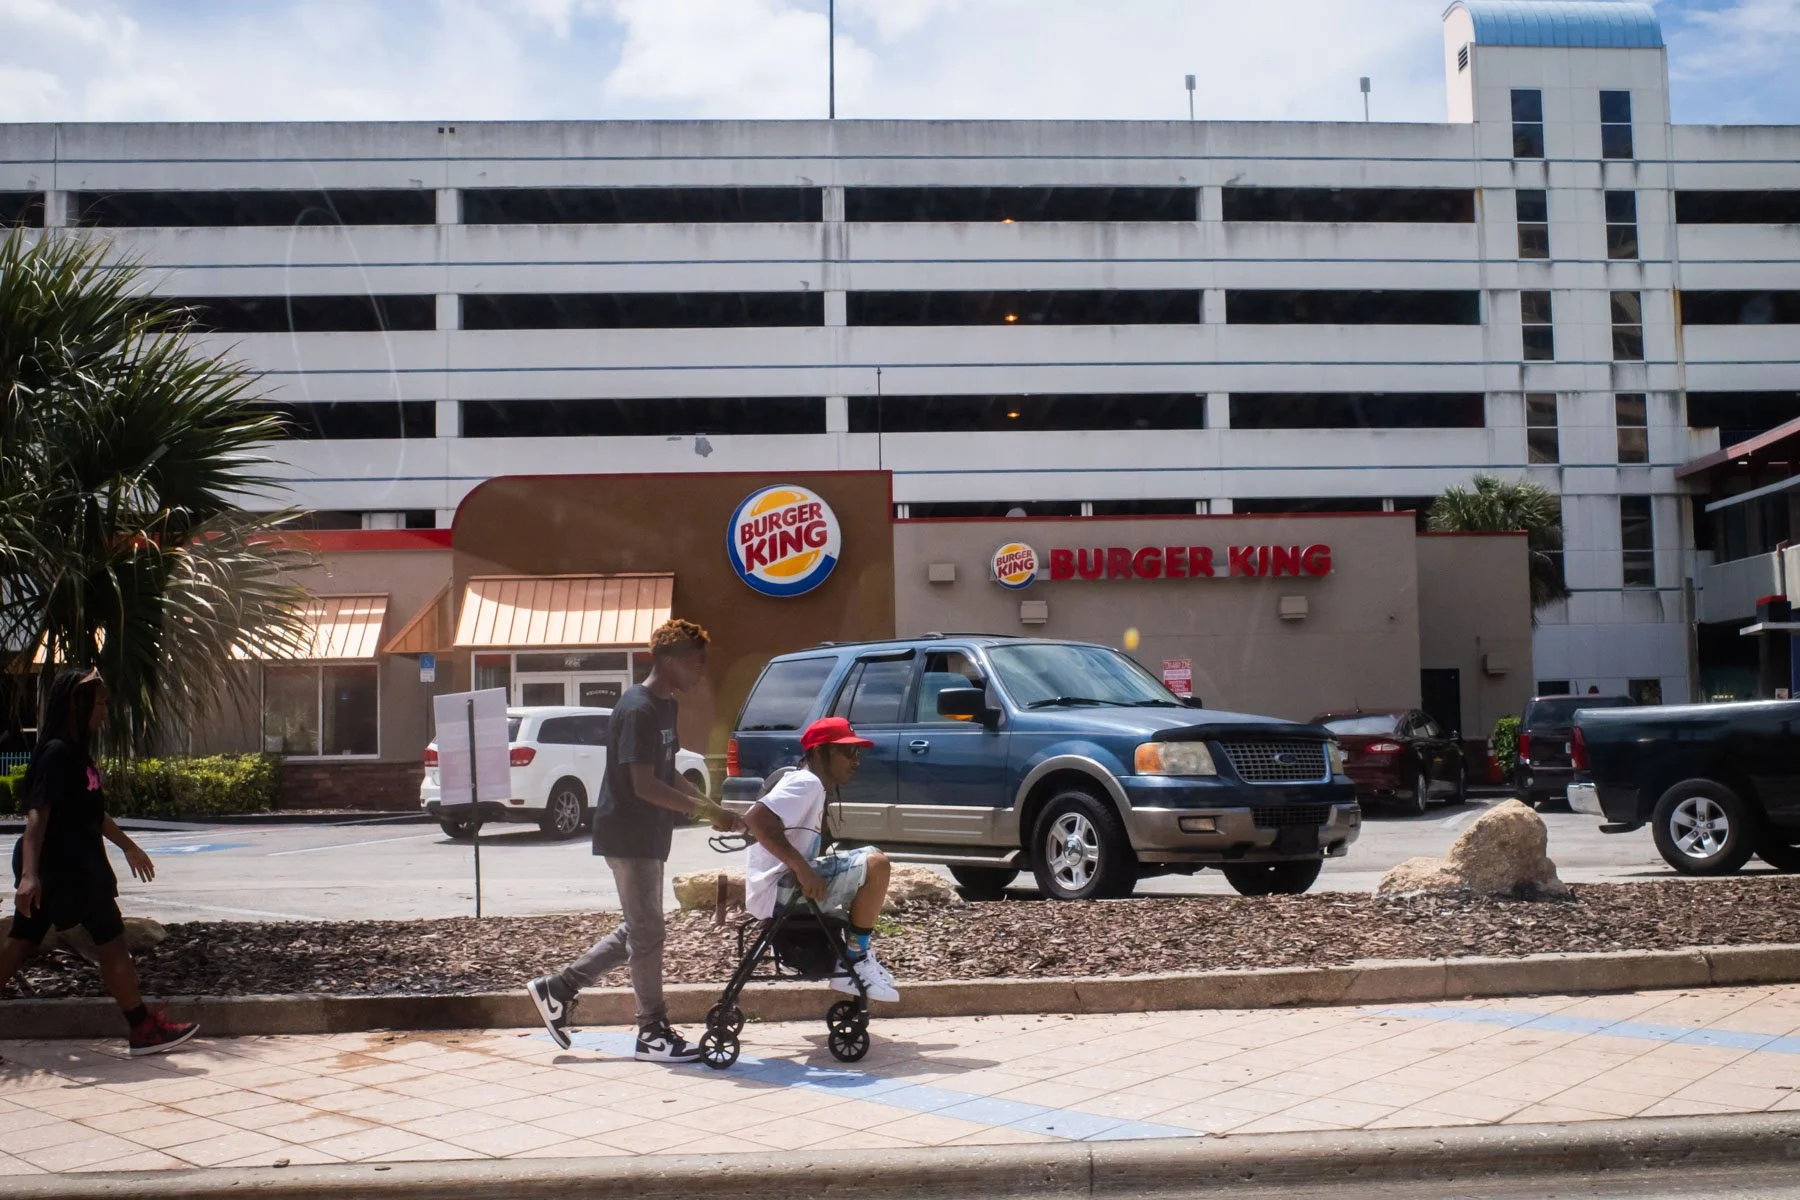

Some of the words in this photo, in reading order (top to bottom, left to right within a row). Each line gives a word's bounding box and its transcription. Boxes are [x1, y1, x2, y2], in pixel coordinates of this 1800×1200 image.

[740, 502, 823, 545] BURGER
[745, 520, 828, 573] KING
[996, 550, 1033, 567] BURGER
[1048, 546, 1215, 581] BURGER
[1227, 544, 1332, 577] KING
[997, 558, 1034, 579] KING
